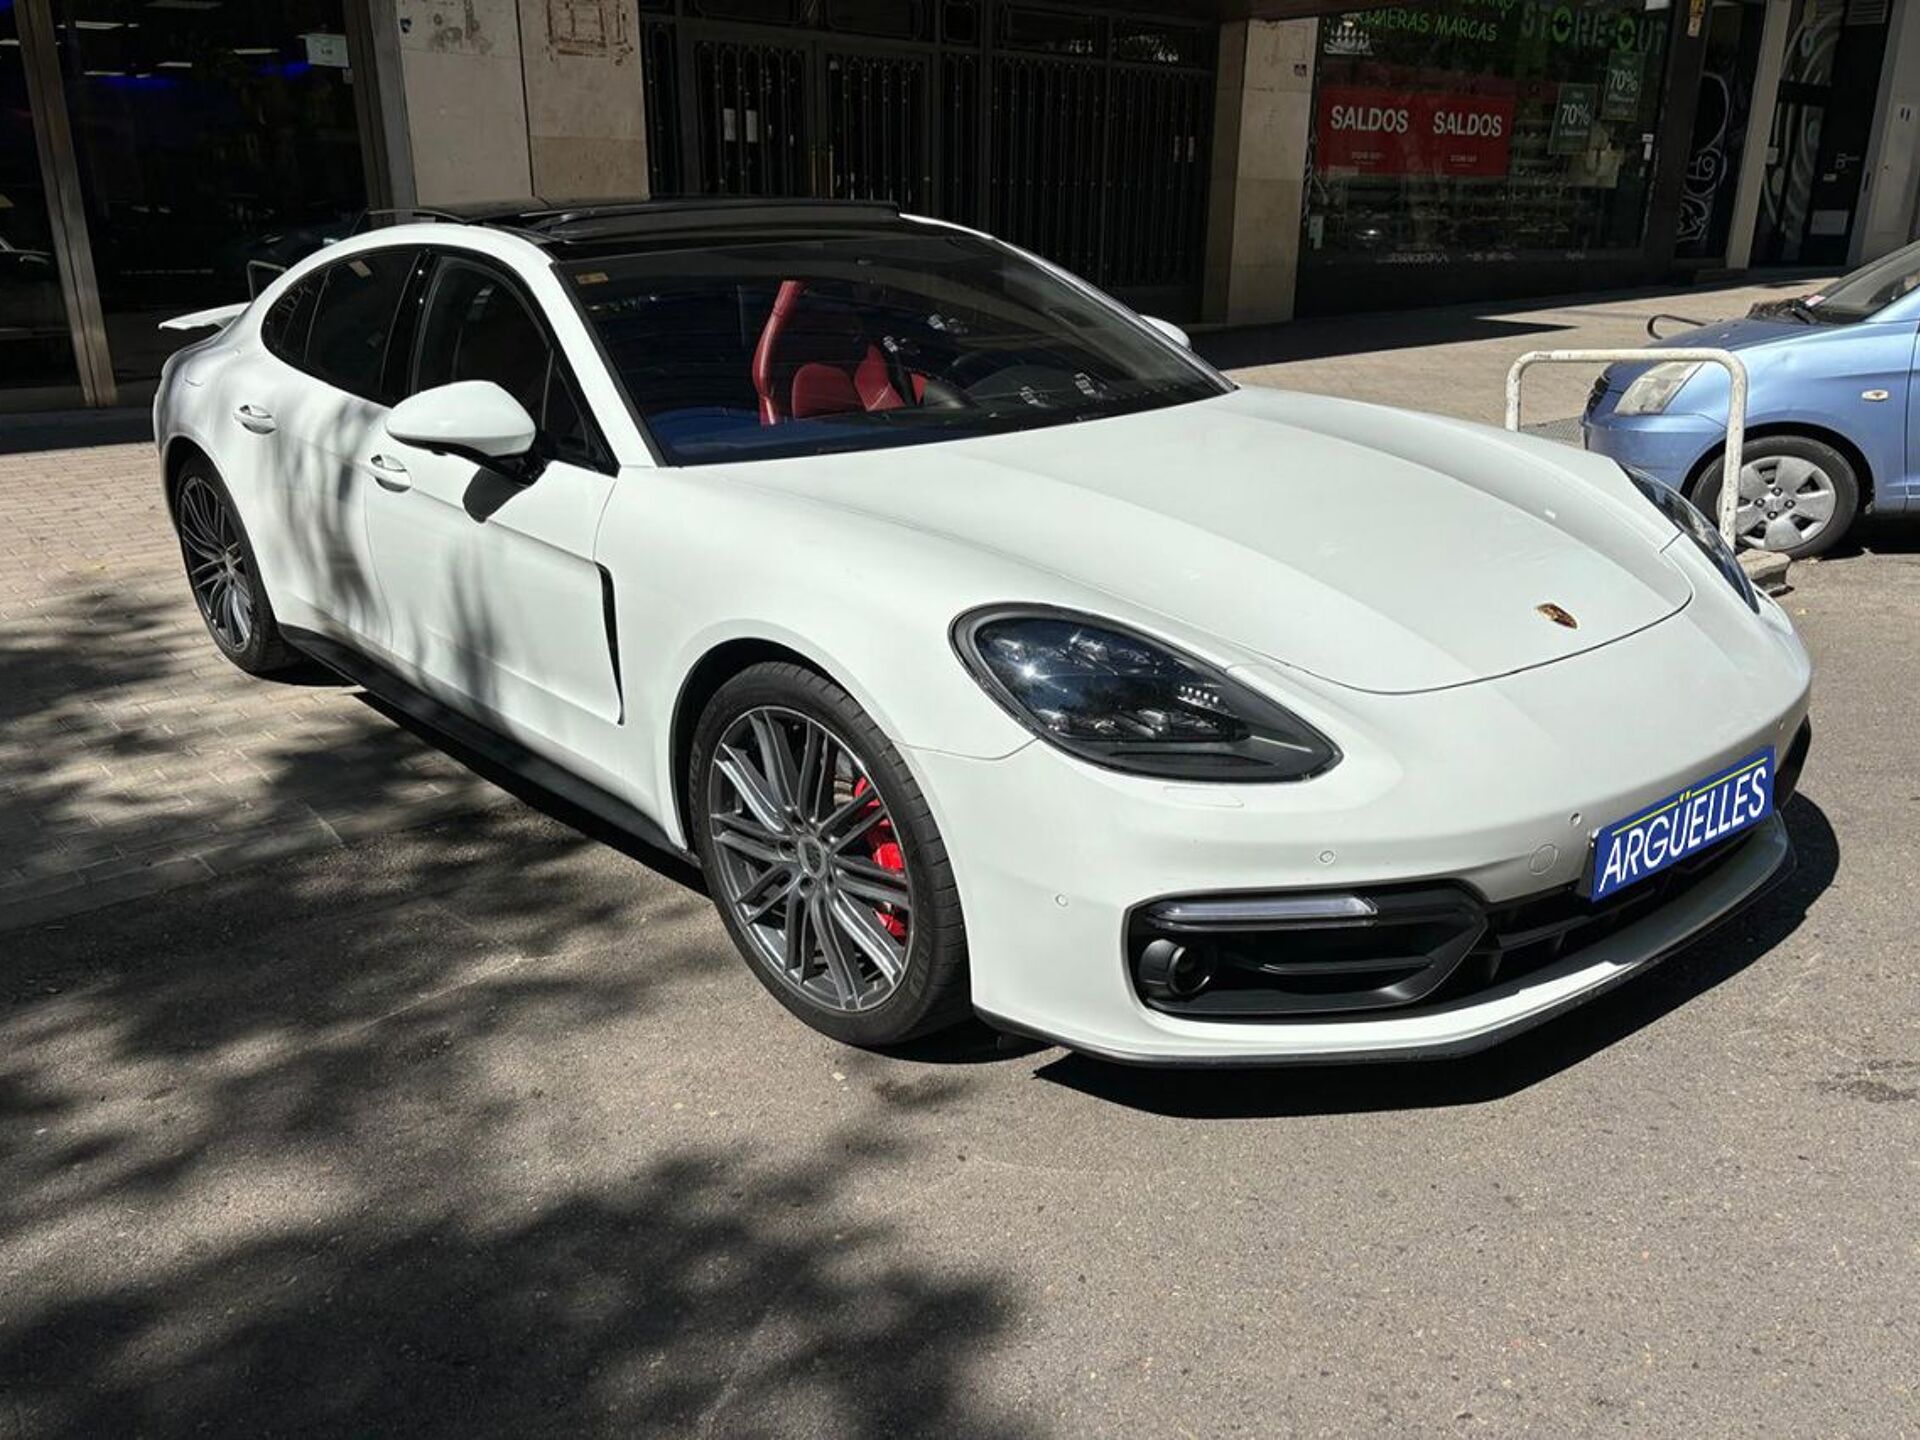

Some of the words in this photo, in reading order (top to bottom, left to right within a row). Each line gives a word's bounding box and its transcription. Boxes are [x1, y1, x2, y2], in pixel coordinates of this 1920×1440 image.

[1434, 15, 1498, 42] MARCAS
[1609, 68, 1639, 92] 70%
[1330, 105, 1409, 134] SALDOS
[1433, 110, 1502, 137] SALDOS
[1560, 103, 1592, 126] 70%
[1598, 766, 1767, 892] ARGÜELLES
